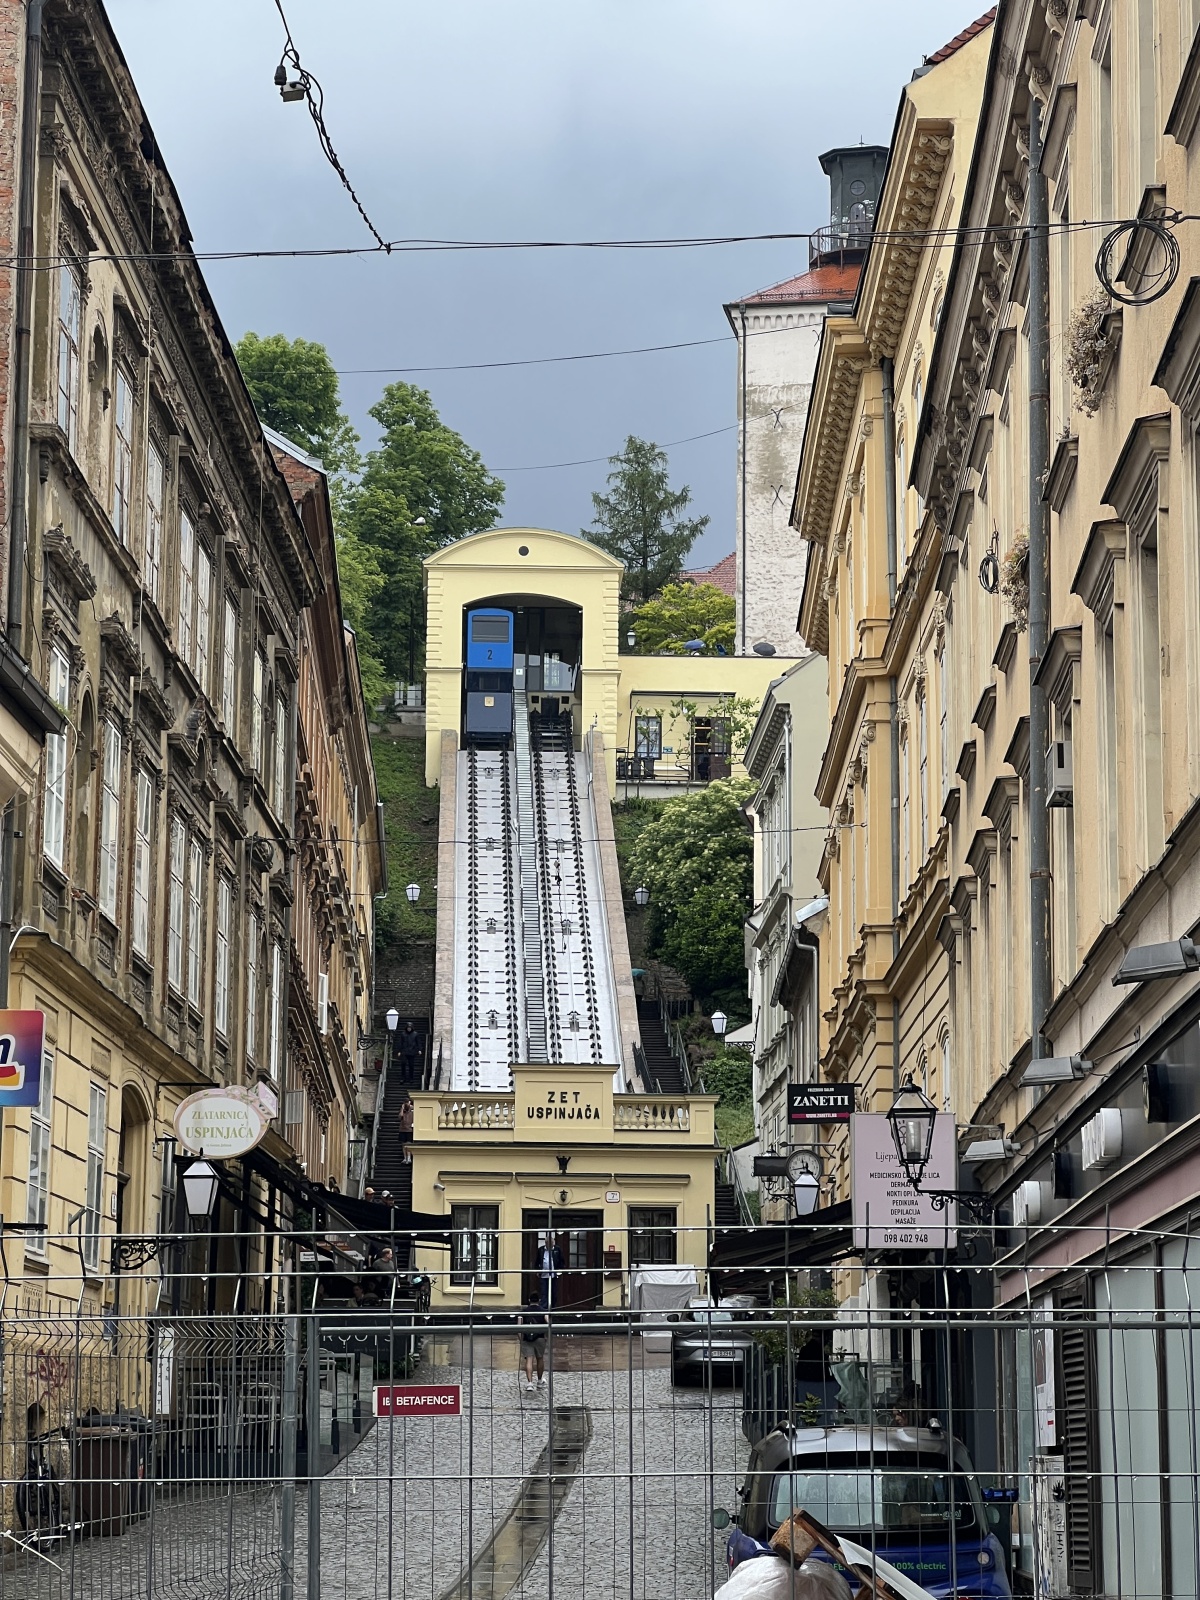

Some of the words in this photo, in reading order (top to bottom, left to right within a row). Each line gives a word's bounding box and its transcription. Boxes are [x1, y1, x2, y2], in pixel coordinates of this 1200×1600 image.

[487, 649, 493, 661] 2
[547, 1091, 581, 1104] ZET
[793, 1095, 849, 1107] ZANETTI
[191, 1110, 249, 1120] ZLATARNICA
[527, 1104, 600, 1120] USPINJAČA
[185, 1123, 254, 1140] USPINJAČA
[890, 1208, 921, 1216] DEPILACIJA
[895, 1217, 917, 1225] MASAŽE
[883, 1234, 898, 1243] 098
[899, 1234, 913, 1243] 402
[914, 1234, 929, 1243] 948
[396, 1395, 455, 1406] BETAFENCE
[916, 1562, 947, 1570] electric
